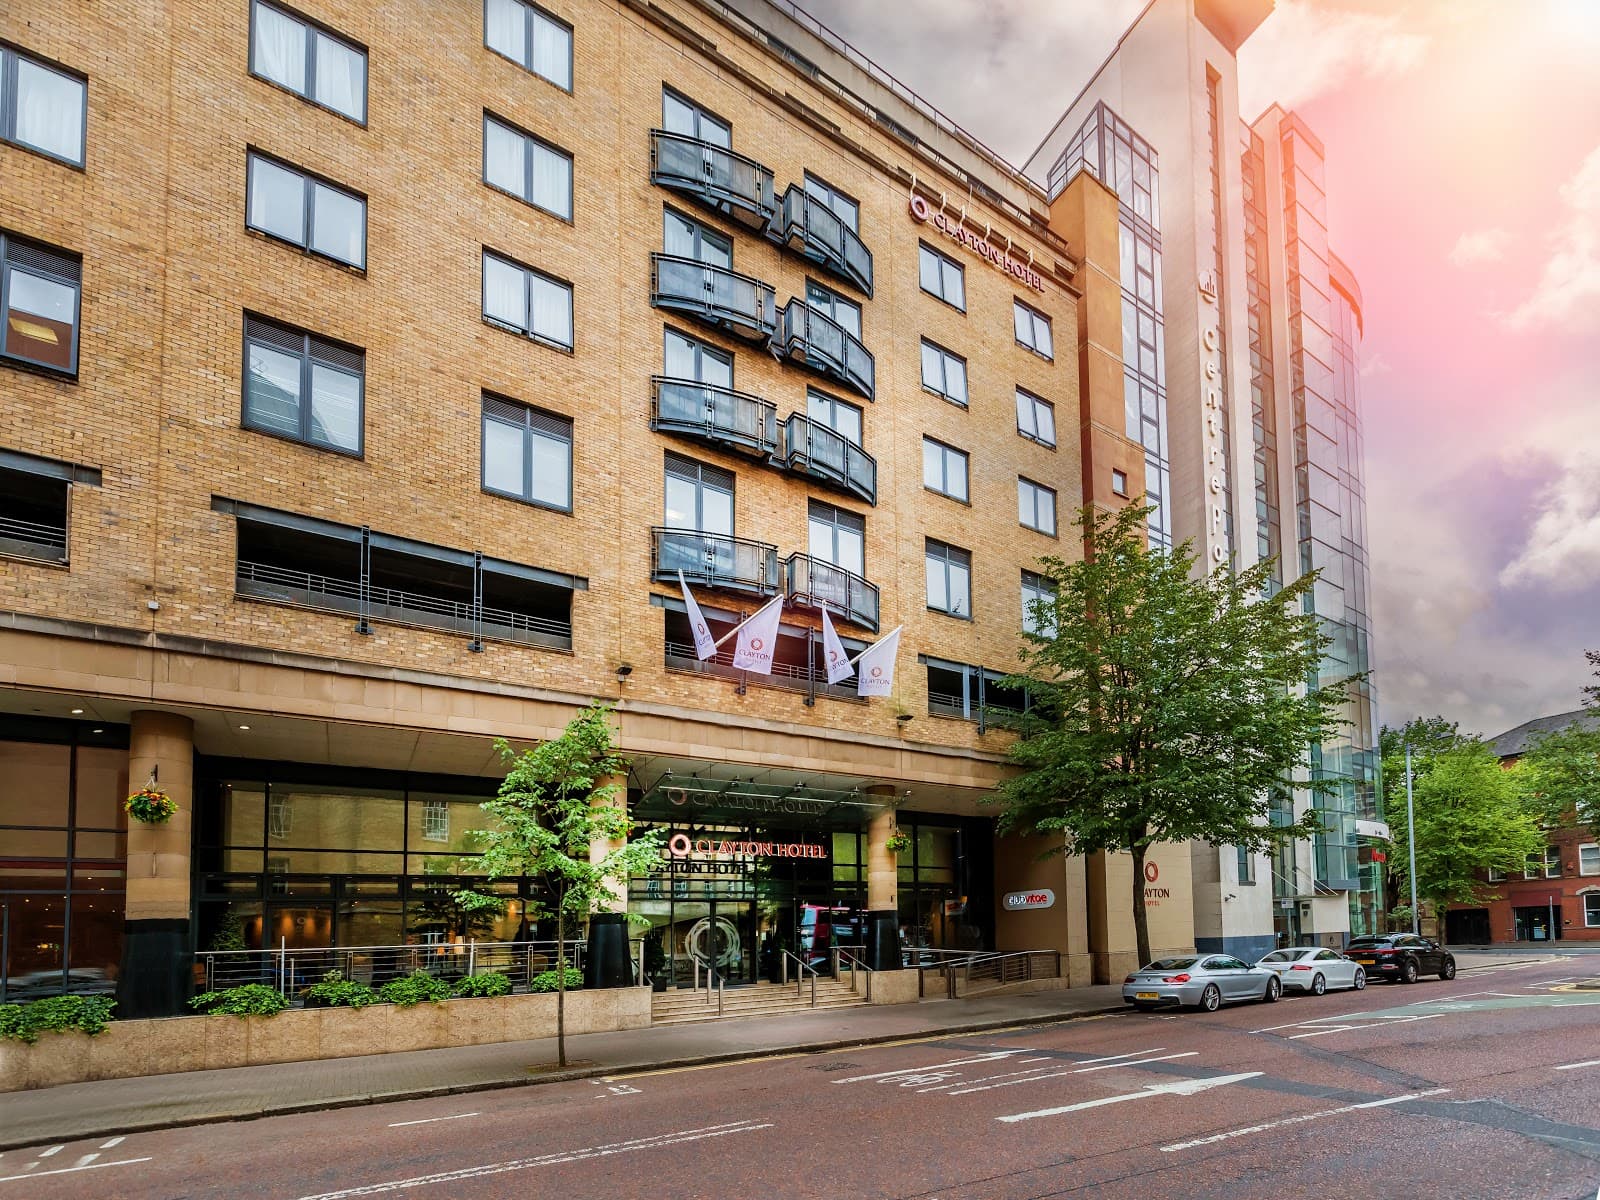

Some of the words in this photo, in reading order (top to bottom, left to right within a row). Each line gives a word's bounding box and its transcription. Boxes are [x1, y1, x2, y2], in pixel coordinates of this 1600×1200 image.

[933, 213, 998, 265] CLAYTON
[1002, 256, 1045, 293] HOTEL
[738, 649, 771, 660] CLAYTON
[696, 839, 773, 857] CLAYTON
[777, 843, 828, 859] HOTEL
[1144, 887, 1170, 898] AYTON
